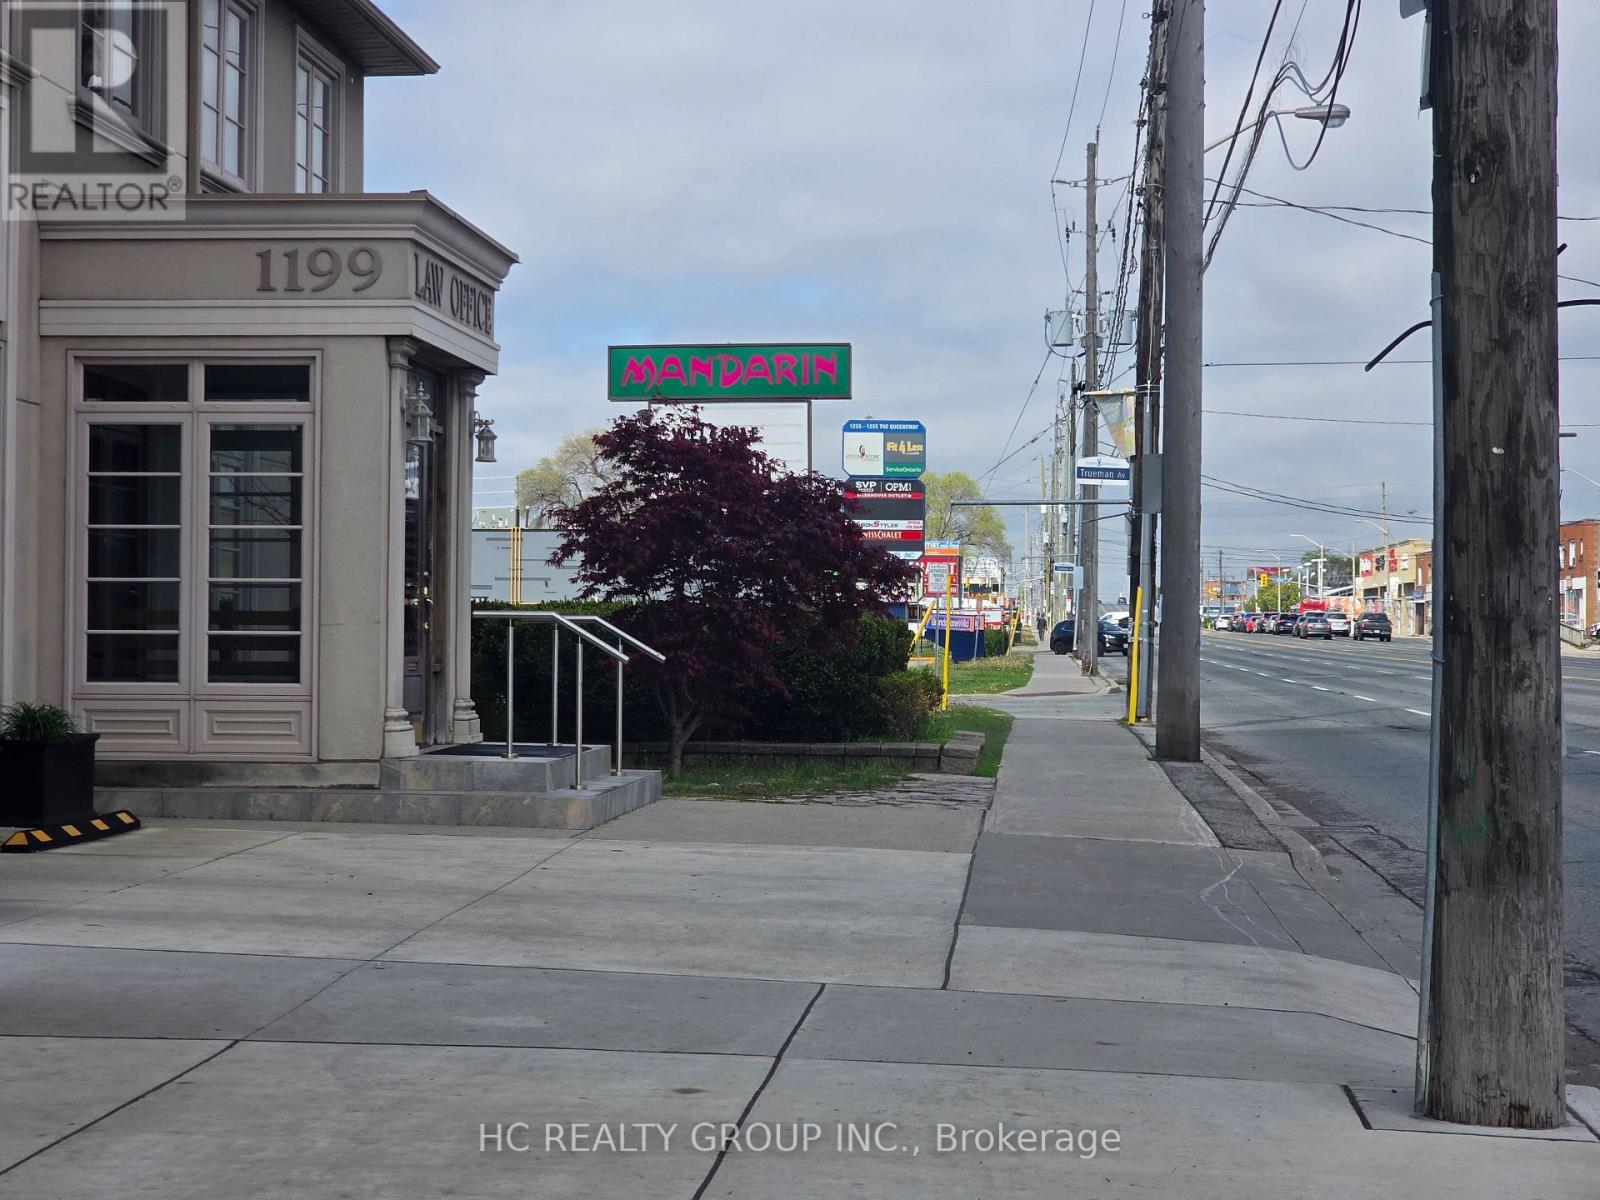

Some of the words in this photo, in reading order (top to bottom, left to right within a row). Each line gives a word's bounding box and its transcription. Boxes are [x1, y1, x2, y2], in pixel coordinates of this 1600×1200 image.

[255, 247, 383, 293] 1199
[413, 252, 445, 308] LAW
[450, 274, 493, 336] OFFICE
[620, 353, 838, 391] MANDARIN
[886, 441, 898, 452] Fit
[899, 440, 906, 454] 4
[855, 481, 877, 489] SVP
[885, 482, 907, 492] OPM
[1080, 468, 1114, 478] Trueman
[1117, 471, 1126, 479] Av
